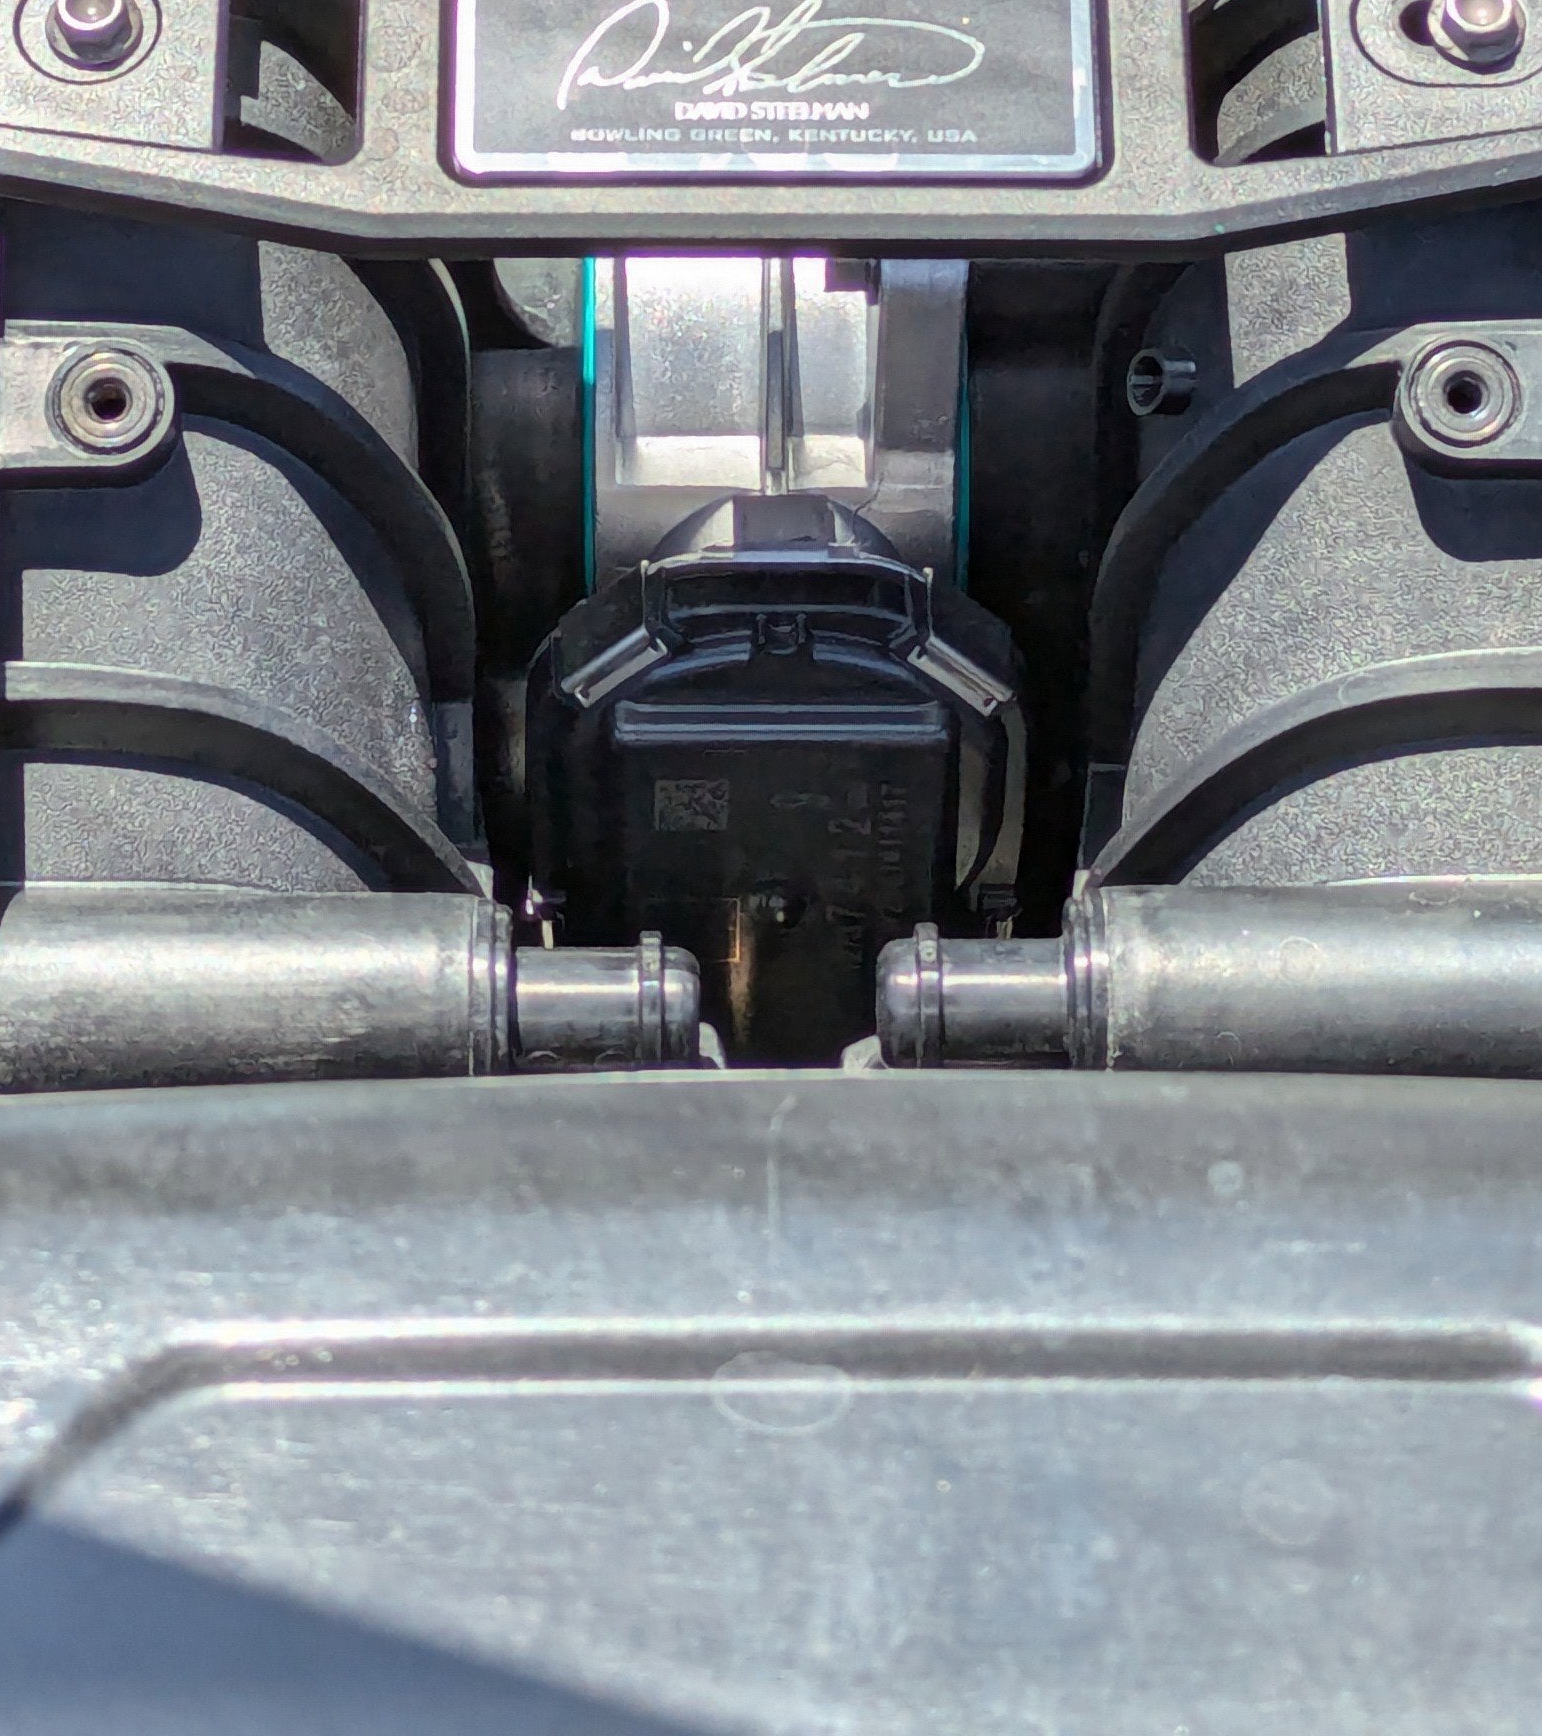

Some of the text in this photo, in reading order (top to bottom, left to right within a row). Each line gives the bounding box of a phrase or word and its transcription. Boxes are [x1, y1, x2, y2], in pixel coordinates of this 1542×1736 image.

[674, 101, 870, 121] DAVID STEELMAN
[570, 128, 681, 142] BOWLING
[927, 129, 979, 143] USA
